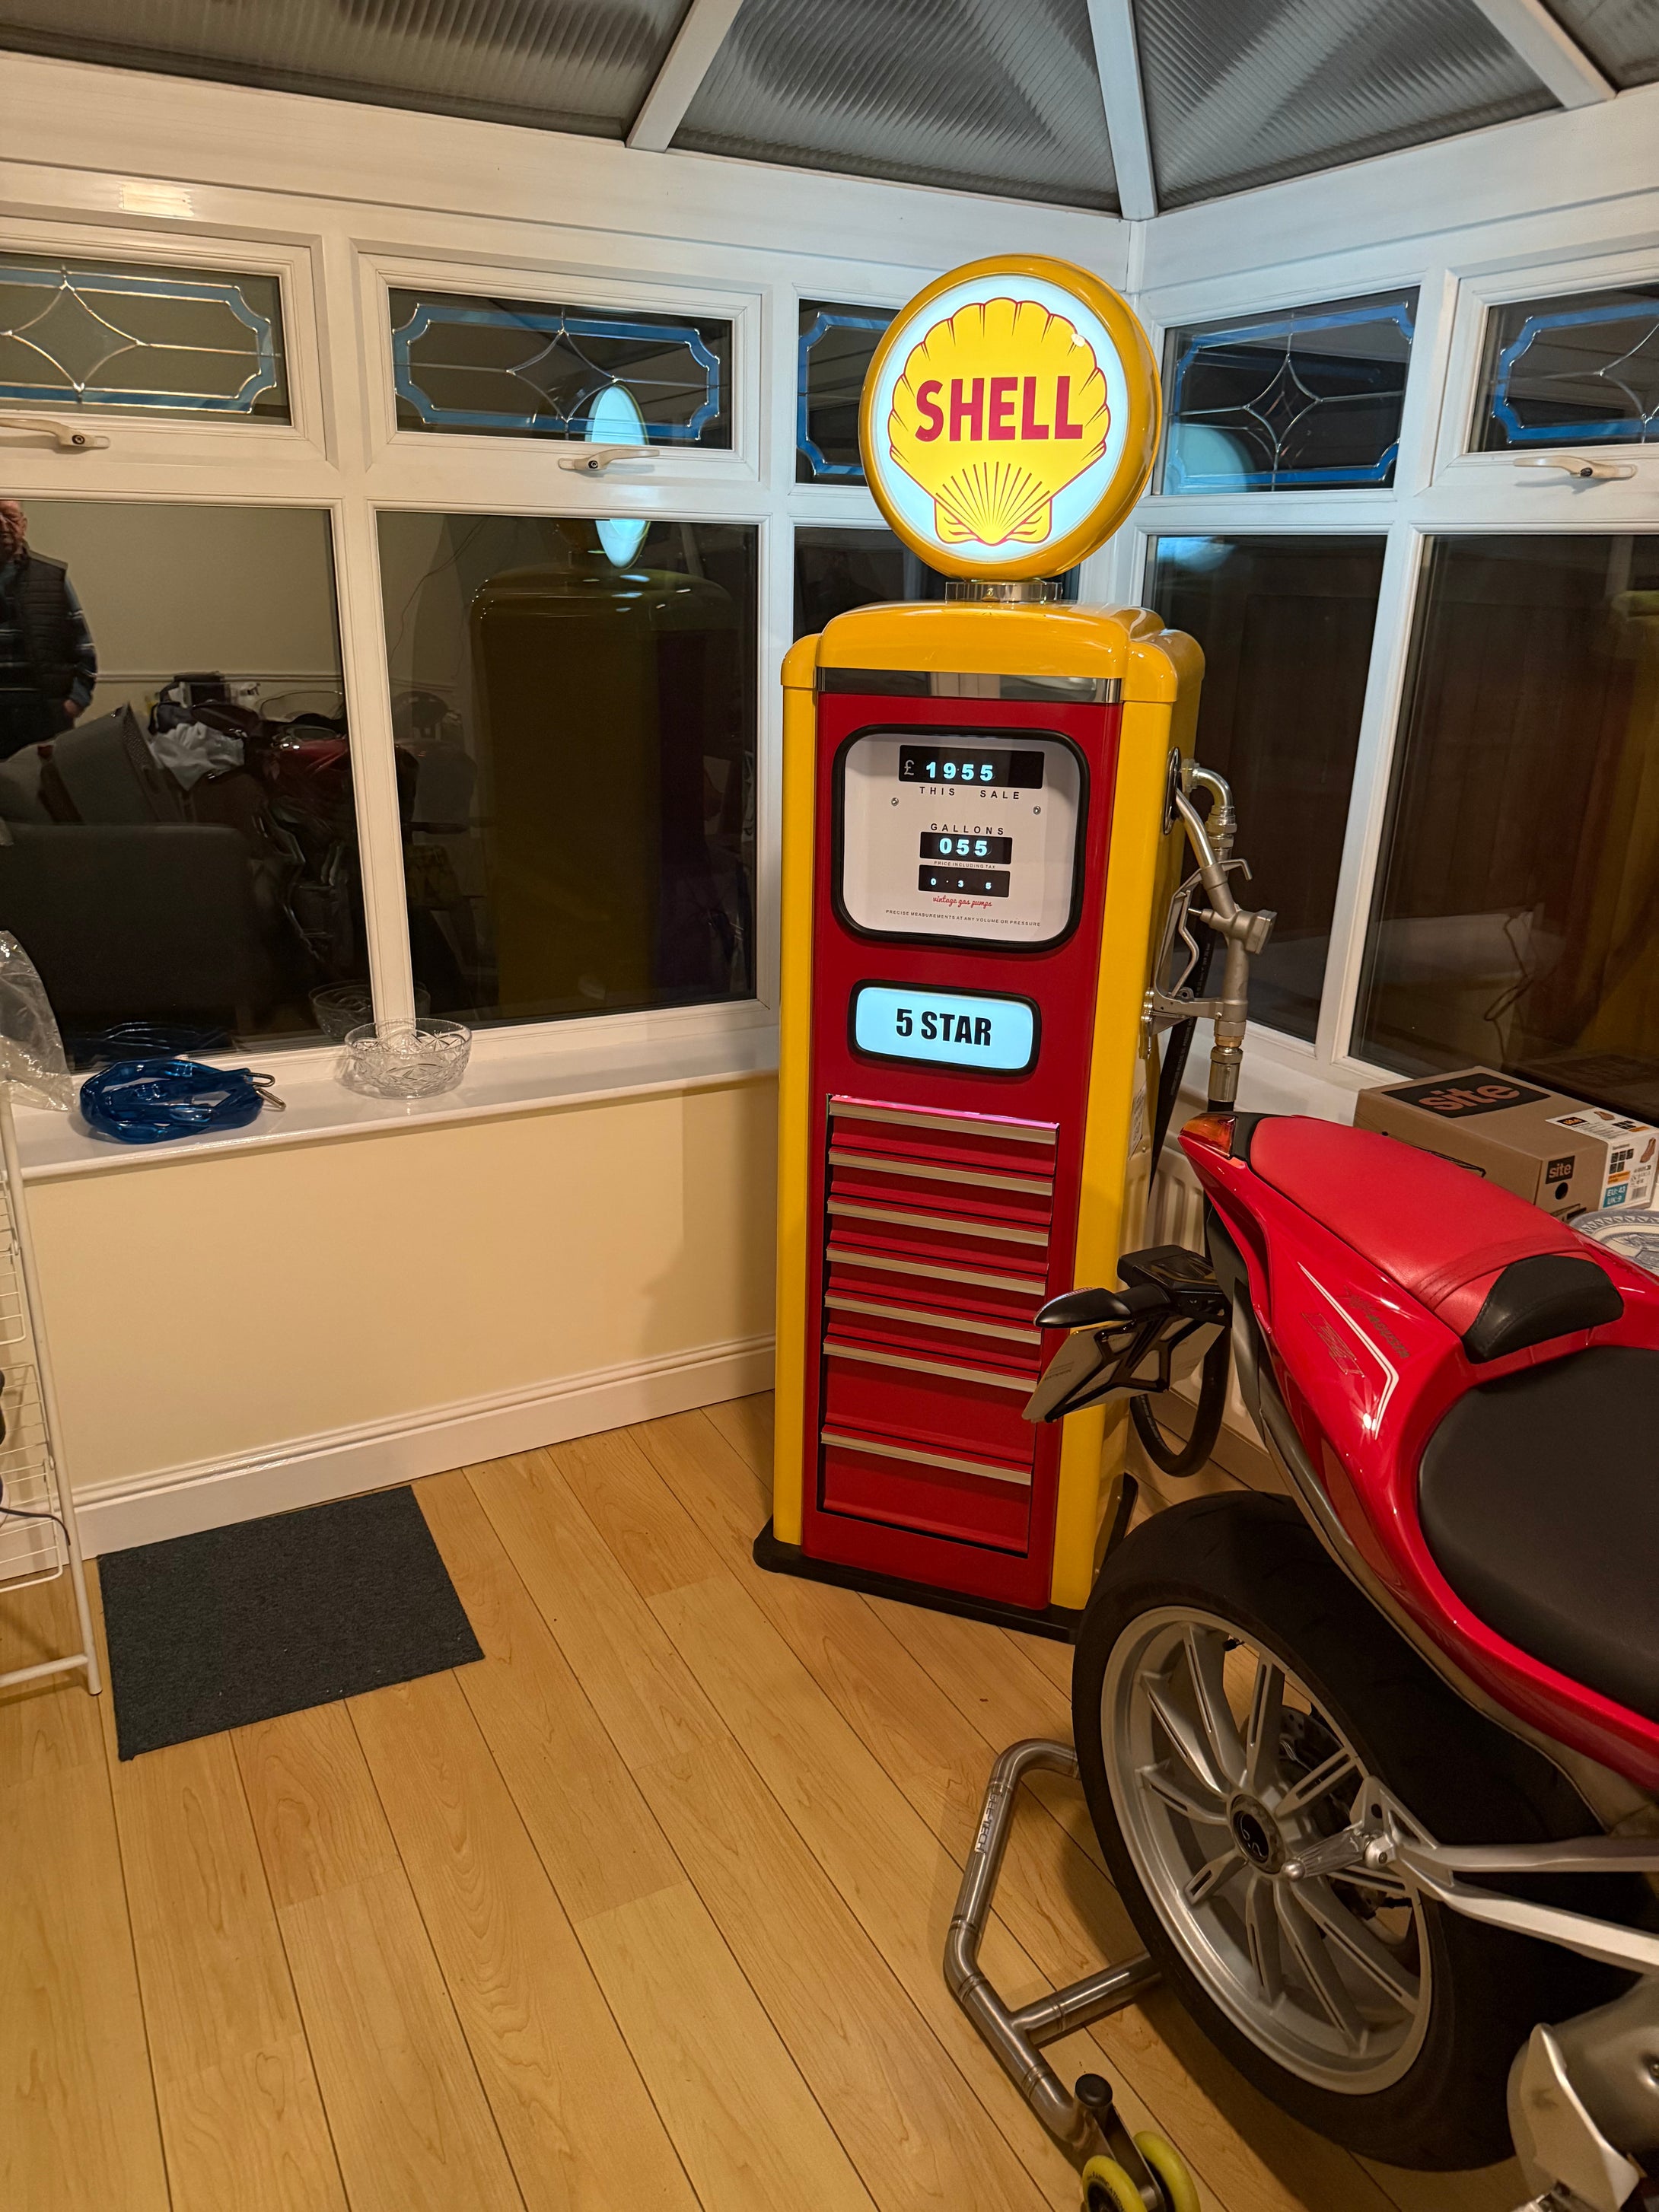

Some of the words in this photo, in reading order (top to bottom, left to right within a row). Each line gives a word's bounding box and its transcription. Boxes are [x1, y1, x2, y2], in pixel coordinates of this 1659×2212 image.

[915, 375, 1084, 442] SHELL
[903, 759, 915, 776] £
[919, 786, 955, 796] THIS
[980, 790, 1020, 800] SALE
[930, 823, 1004, 835] GALLONS
[938, 837, 989, 857] 055
[932, 895, 957, 907] vintage
[971, 901, 993, 909] pumps
[910, 912, 955, 920] MEASUREMENTS
[896, 1008, 913, 1037] 5
[921, 1011, 992, 1046] STAR
[1419, 1084, 1520, 1111] site
[1549, 1163, 1572, 1179] site
